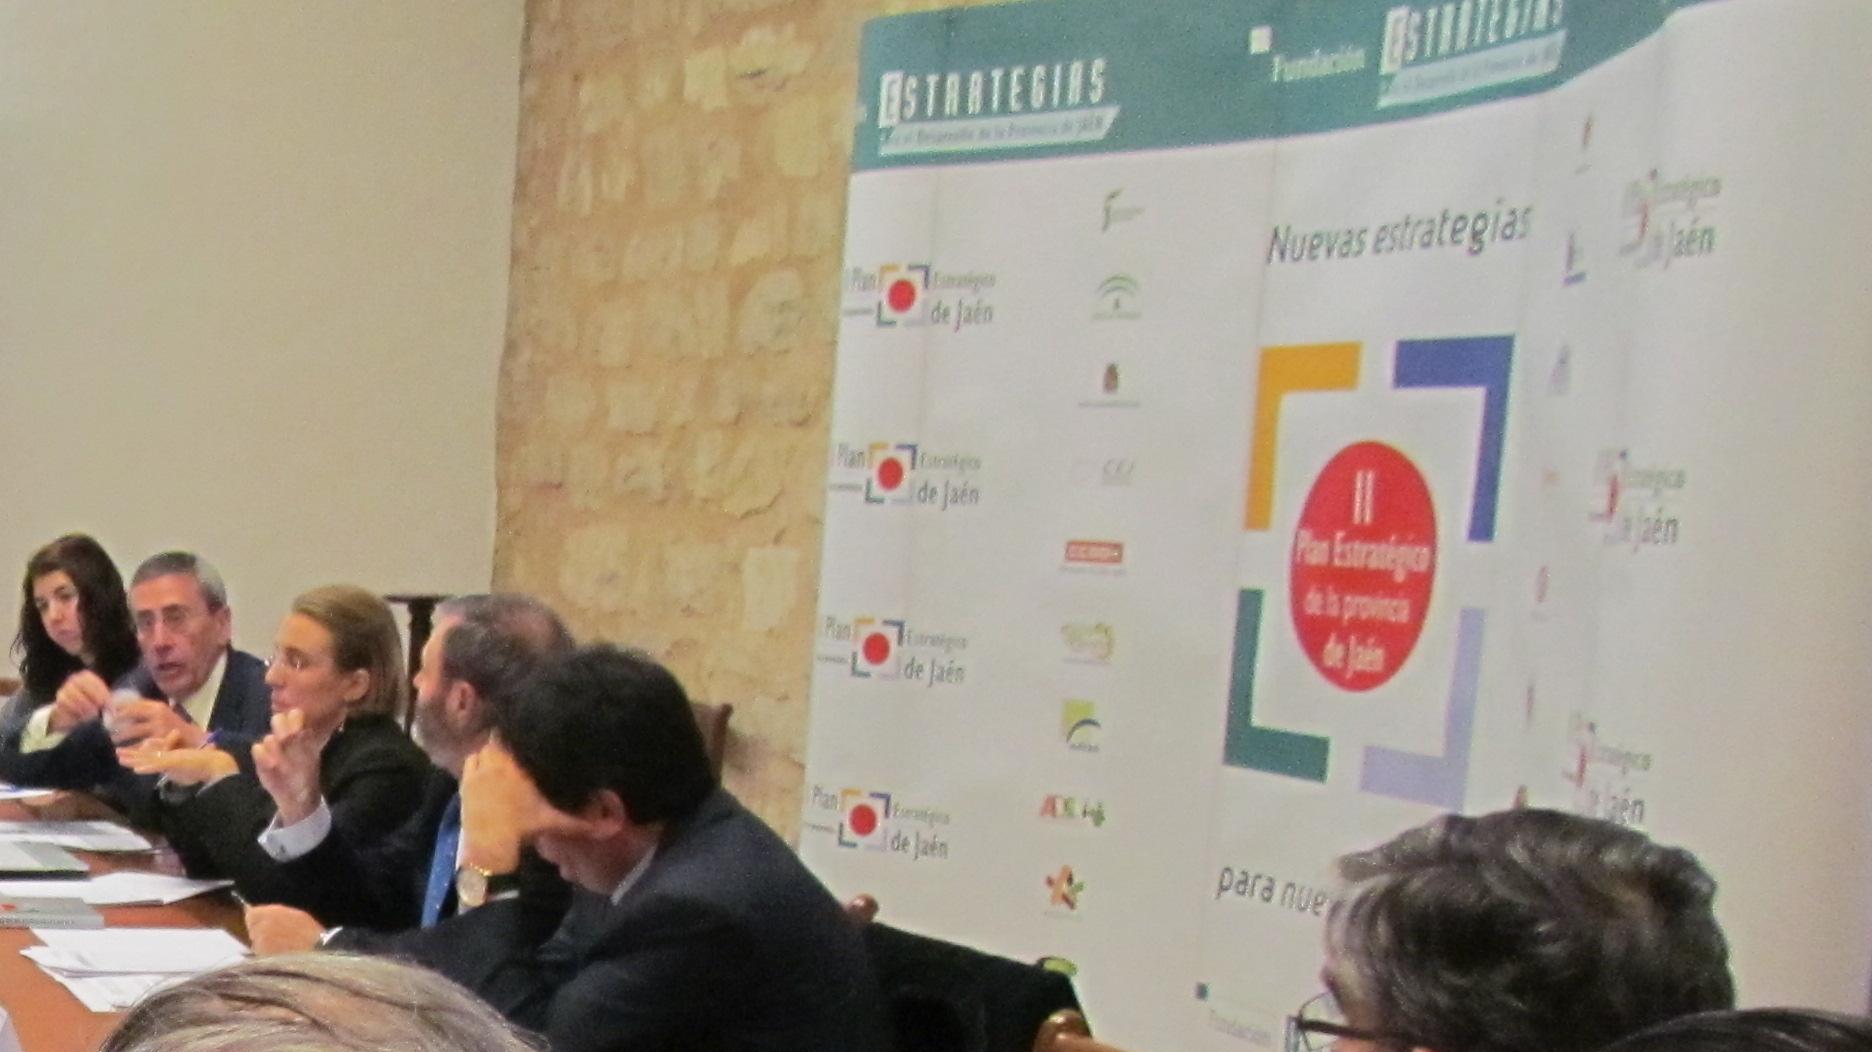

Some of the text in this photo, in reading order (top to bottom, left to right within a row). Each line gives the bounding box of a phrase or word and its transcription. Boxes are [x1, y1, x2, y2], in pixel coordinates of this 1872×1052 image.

[878, 56, 1107, 128] ESTRATEGIAS
[1267, 197, 1534, 264] Nuevas estrategias
[918, 479, 980, 512] de Jaén
[1353, 469, 1375, 526] II
[1296, 529, 1330, 567] Plan
[904, 655, 966, 688] de Jaén
[1322, 630, 1386, 680] de Jaén
[891, 829, 949, 862] de Jaén
[1214, 866, 1329, 917] para nue
